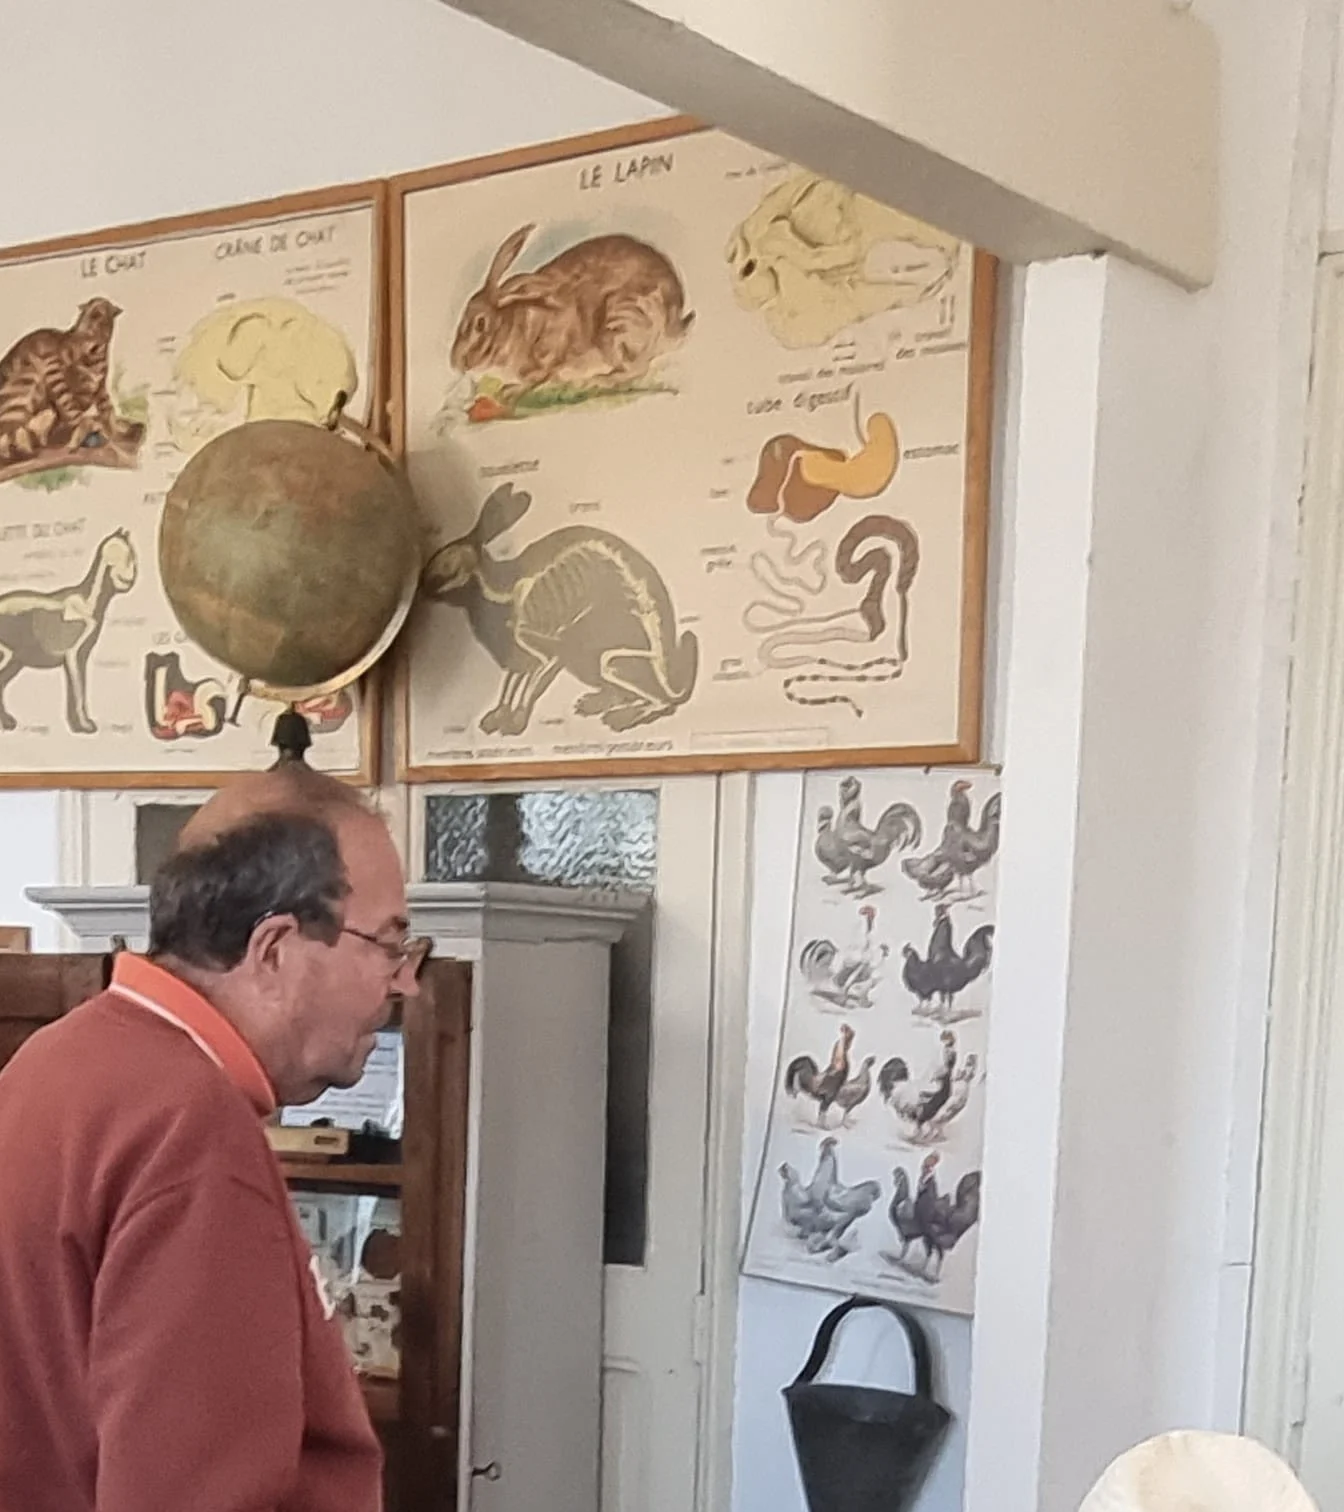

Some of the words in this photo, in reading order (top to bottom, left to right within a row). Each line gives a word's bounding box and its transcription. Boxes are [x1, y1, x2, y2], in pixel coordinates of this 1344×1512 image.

[579, 163, 602, 190] LE
[613, 152, 674, 183] LAPIN
[80, 257, 99, 279] LE
[105, 250, 147, 274] CHAT
